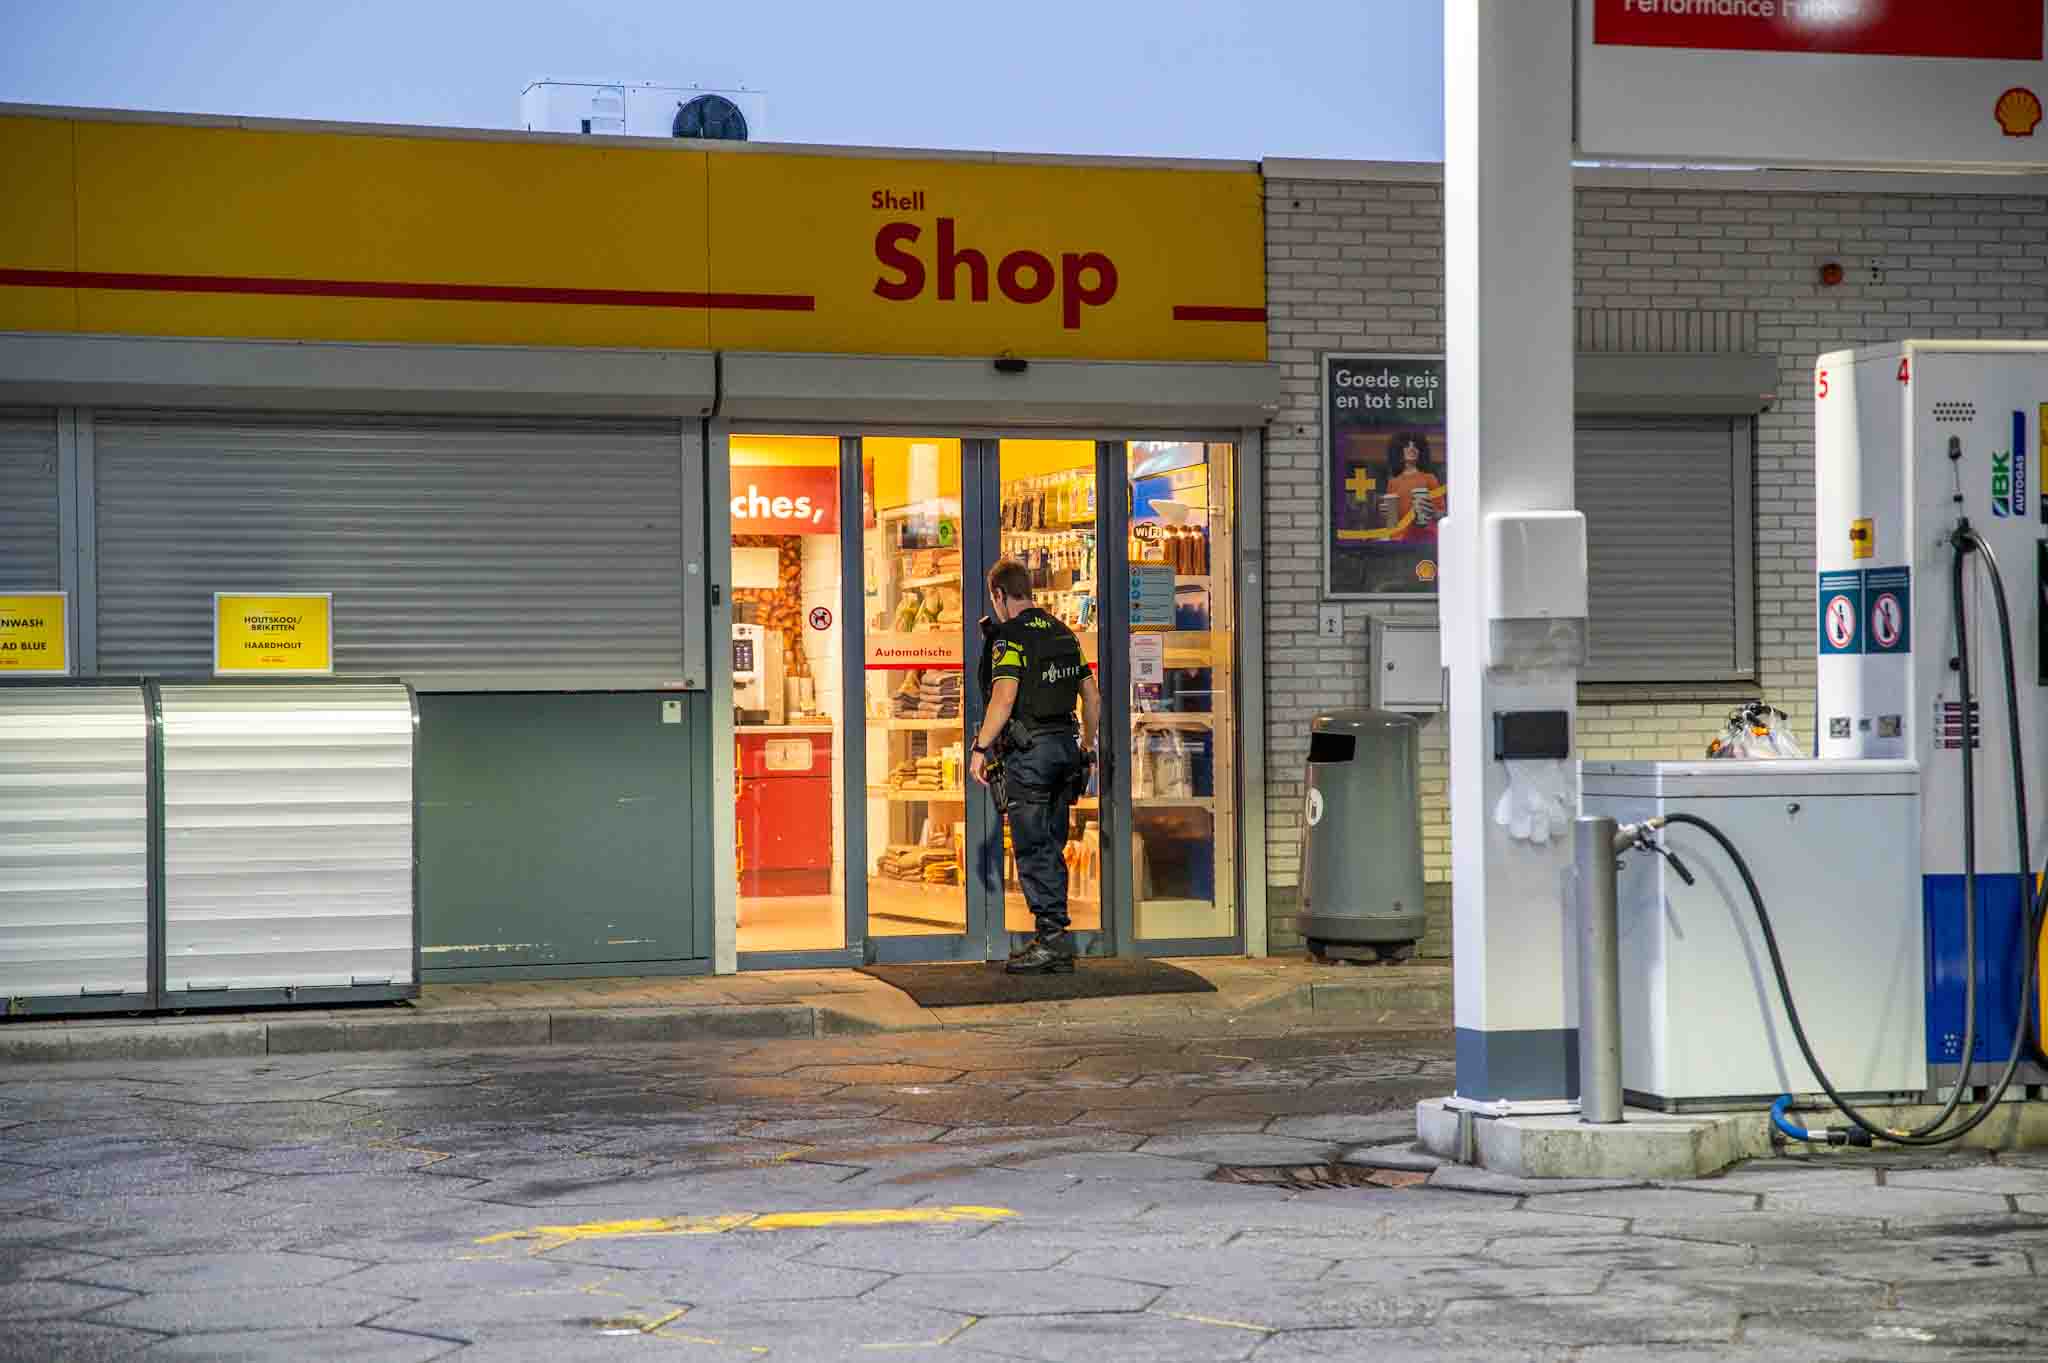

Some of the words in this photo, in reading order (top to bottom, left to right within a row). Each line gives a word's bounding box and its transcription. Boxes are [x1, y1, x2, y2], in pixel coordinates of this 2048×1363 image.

[871, 190, 925, 211] Shell
[873, 217, 1118, 329] Shop
[1336, 368, 1400, 388] Goede
[1405, 369, 1440, 388] reis
[1896, 358, 1911, 385] 4
[1817, 371, 1829, 398] 5
[1336, 396, 1359, 409] en
[1365, 393, 1392, 409] tot
[1397, 390, 1433, 409] snel
[2015, 455, 2025, 512] AUTOGAS
[730, 485, 824, 525] ches,
[21, 642, 48, 651] BLUE
[244, 641, 302, 649] HAARDHOUT
[875, 648, 952, 657] Automatische
